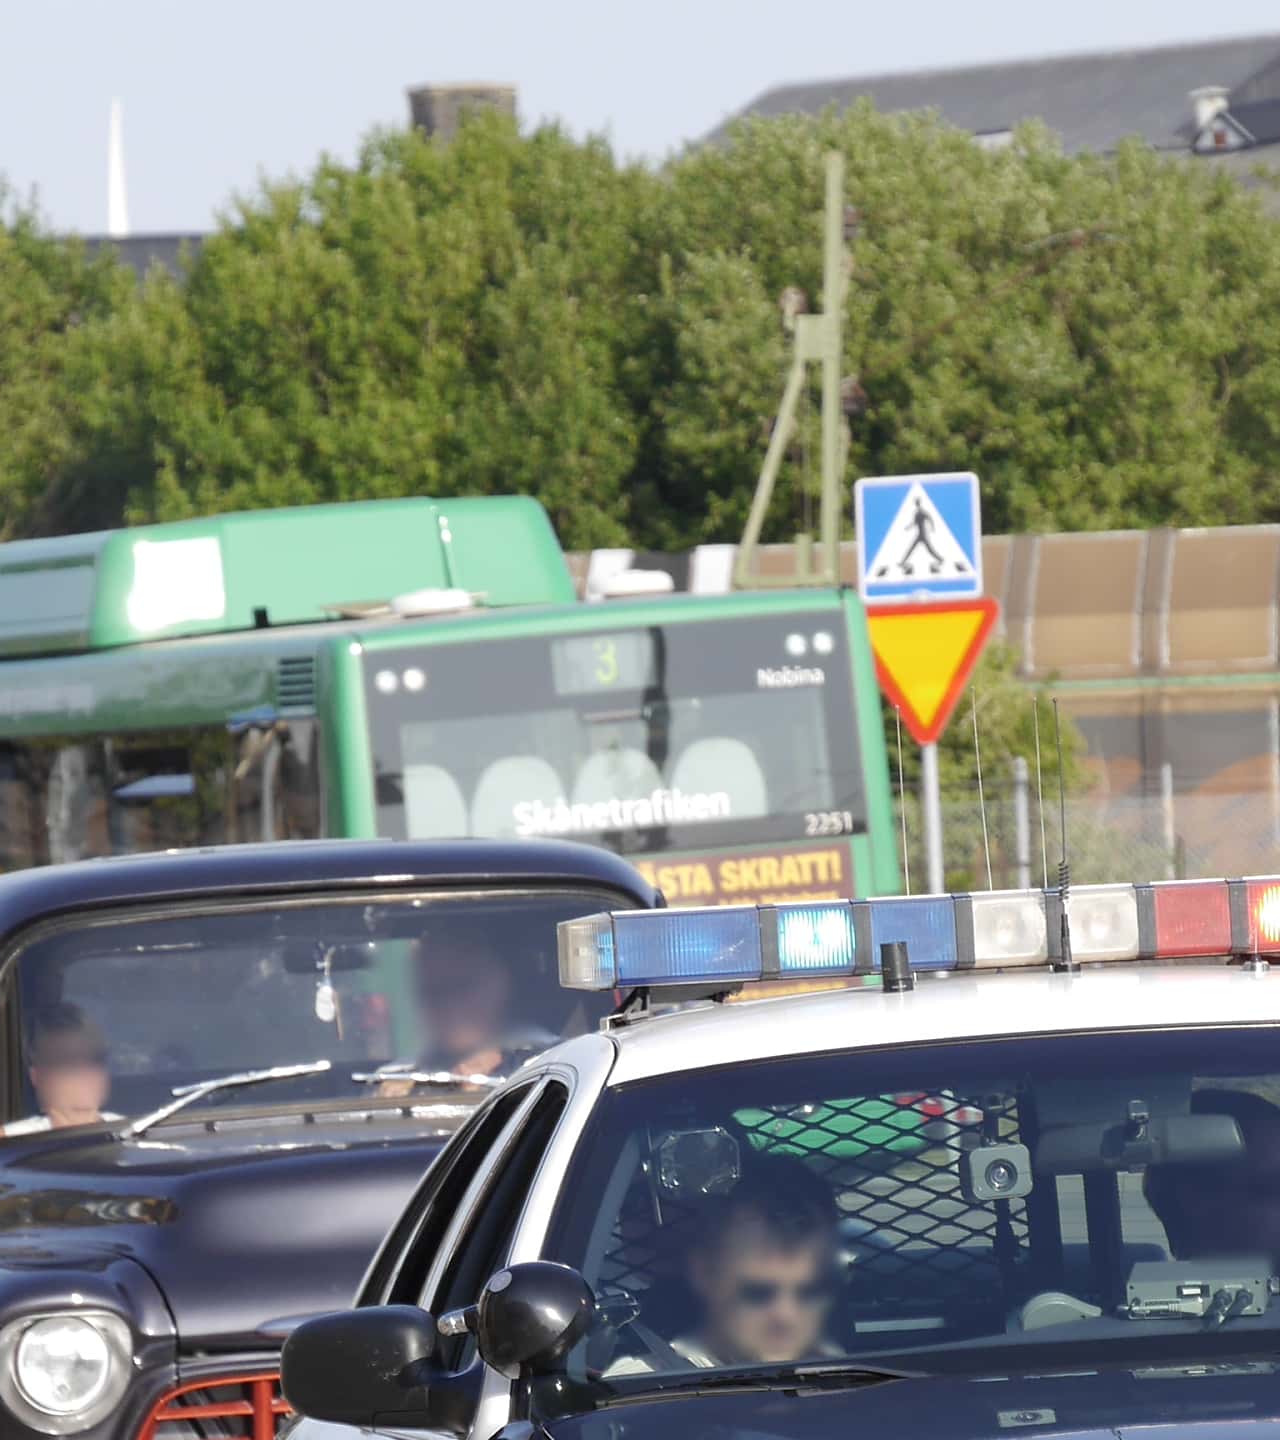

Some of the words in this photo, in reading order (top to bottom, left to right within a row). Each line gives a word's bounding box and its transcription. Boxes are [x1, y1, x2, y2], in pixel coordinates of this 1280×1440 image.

[592, 640, 619, 685] 3
[757, 665, 825, 688] Nobina
[512, 788, 731, 835] Skånetrafiken
[719, 849, 842, 893] SKRATT!
